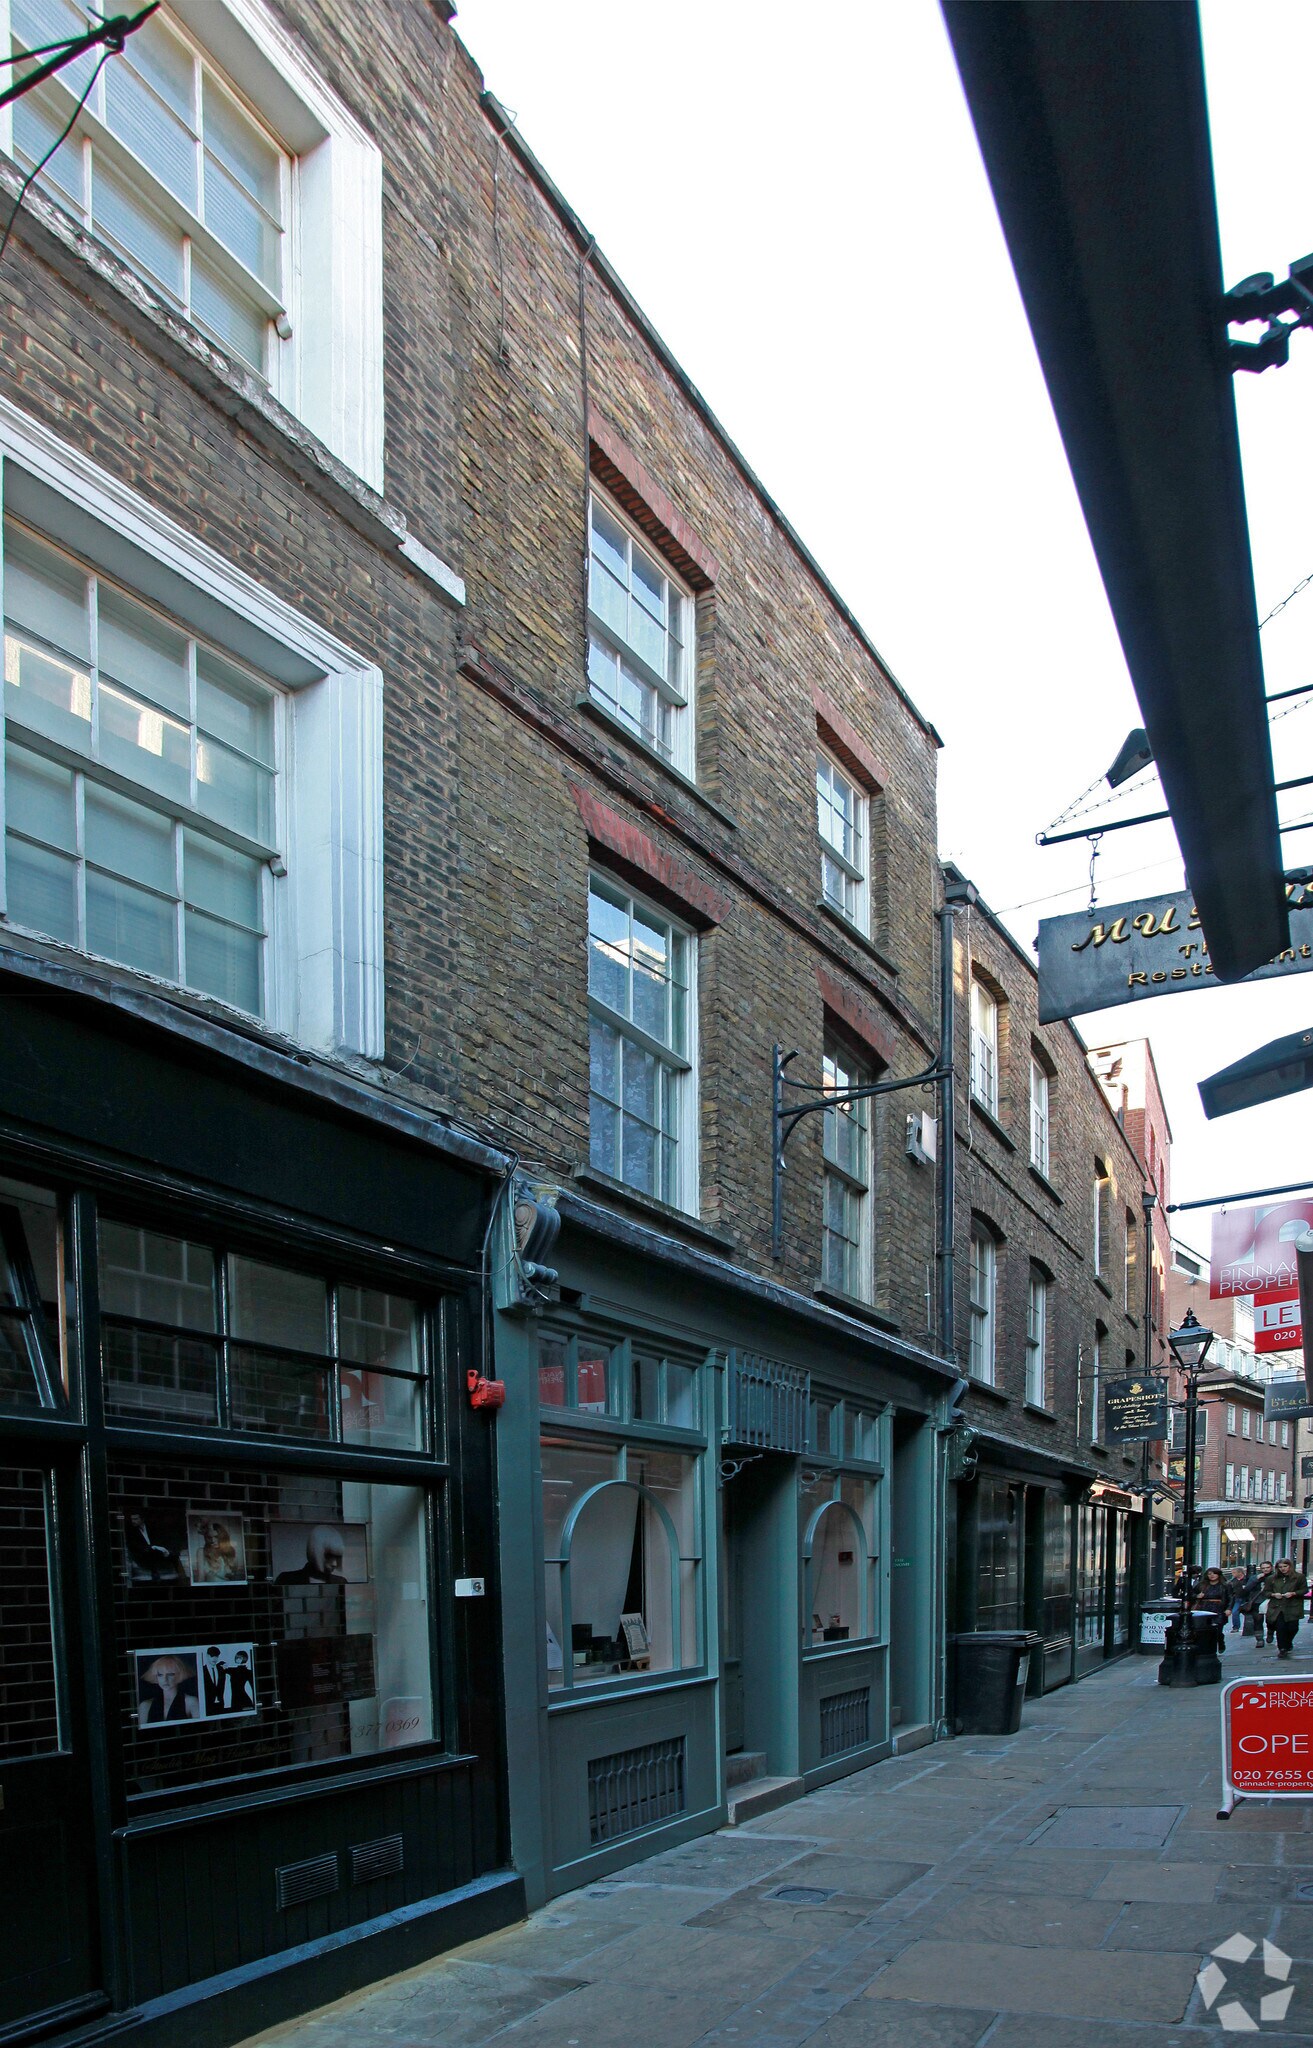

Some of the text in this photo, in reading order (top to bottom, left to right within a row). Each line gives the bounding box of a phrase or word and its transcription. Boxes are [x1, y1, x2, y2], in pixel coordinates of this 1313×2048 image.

[1274, 1330, 1297, 1341] 020
[1107, 1393, 1165, 1404] GRAPESHOTS
[1238, 1734, 1309, 1754] OPE
[1233, 1770, 1261, 1780] 020
[1265, 1770, 1302, 1780] 7655
